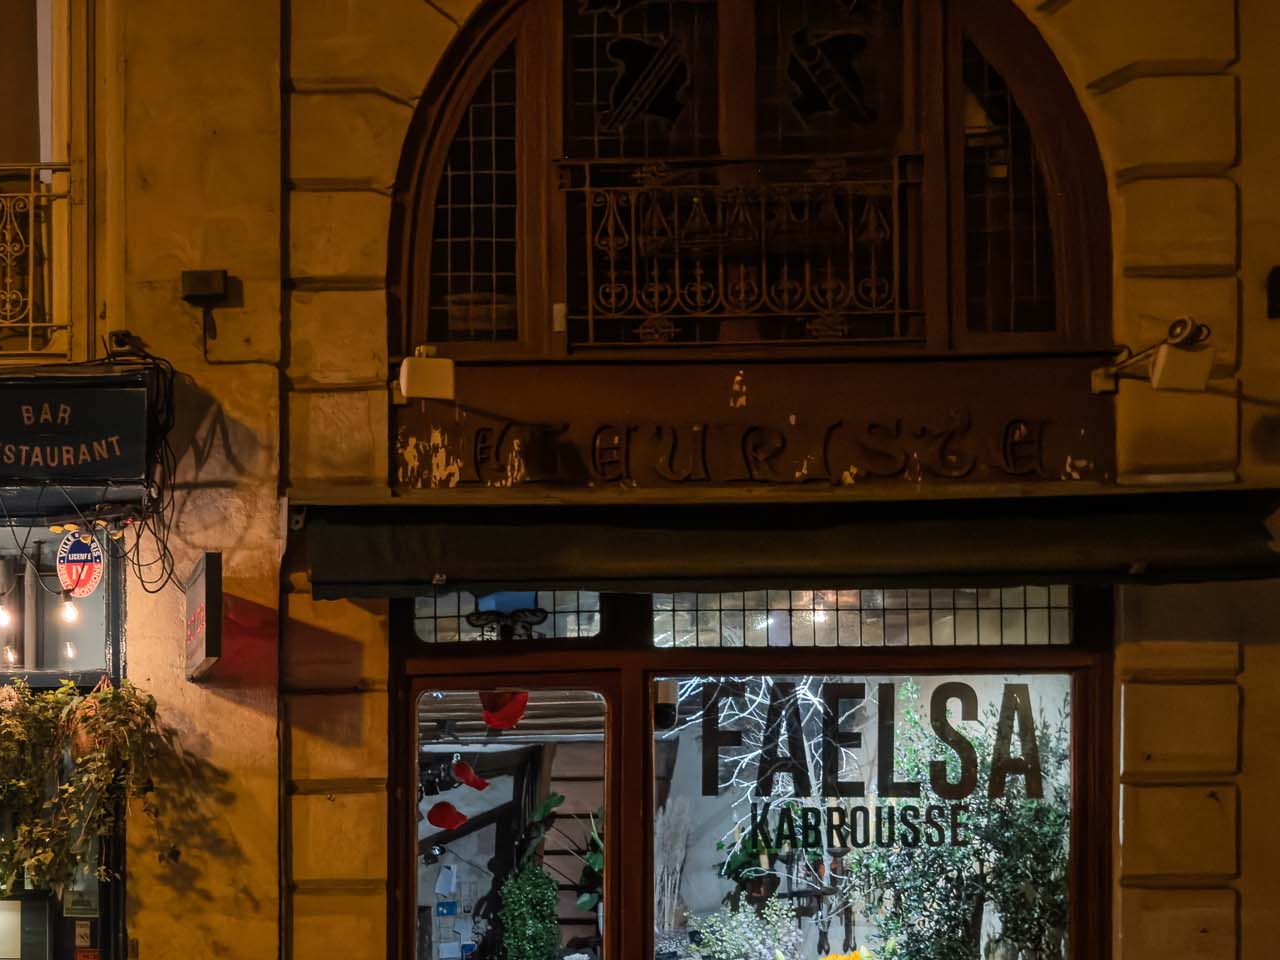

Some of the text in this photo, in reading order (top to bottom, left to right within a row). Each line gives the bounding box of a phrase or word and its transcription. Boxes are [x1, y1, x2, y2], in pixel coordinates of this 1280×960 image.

[22, 402, 72, 425] BAR
[701, 682, 1043, 800] FAELSA
[750, 803, 971, 850] KABROUSSE
